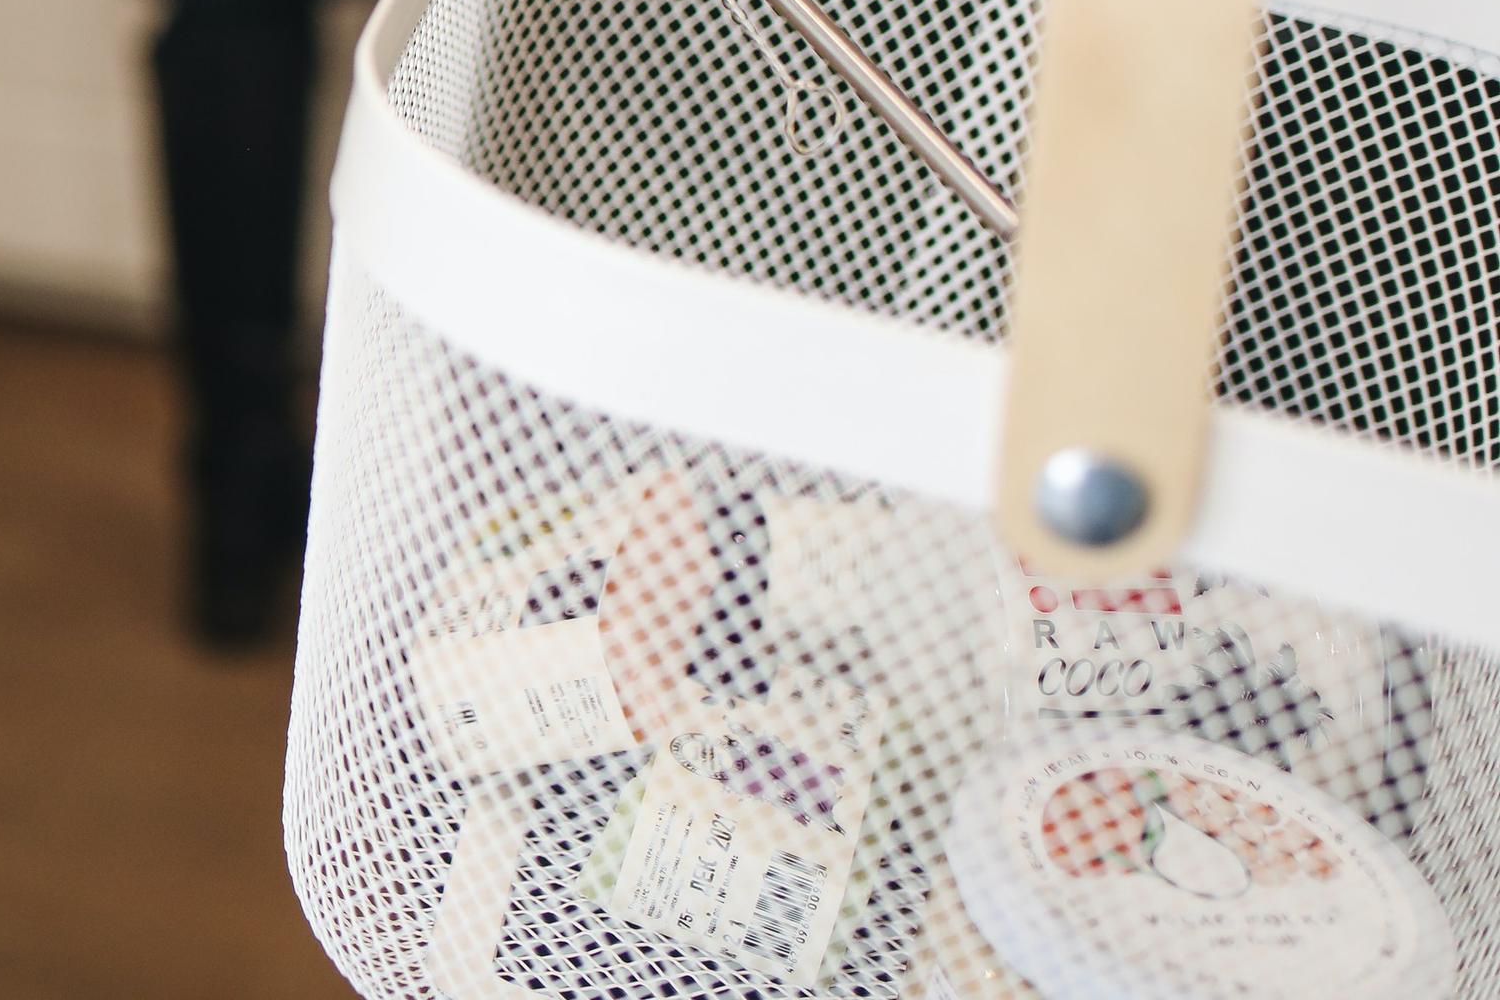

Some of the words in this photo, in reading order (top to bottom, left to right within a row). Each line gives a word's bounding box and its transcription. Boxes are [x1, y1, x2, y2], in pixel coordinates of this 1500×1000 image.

[1032, 619, 1186, 651] RAW
[1037, 657, 1155, 697] COCO
[705, 812, 737, 852] 2021
